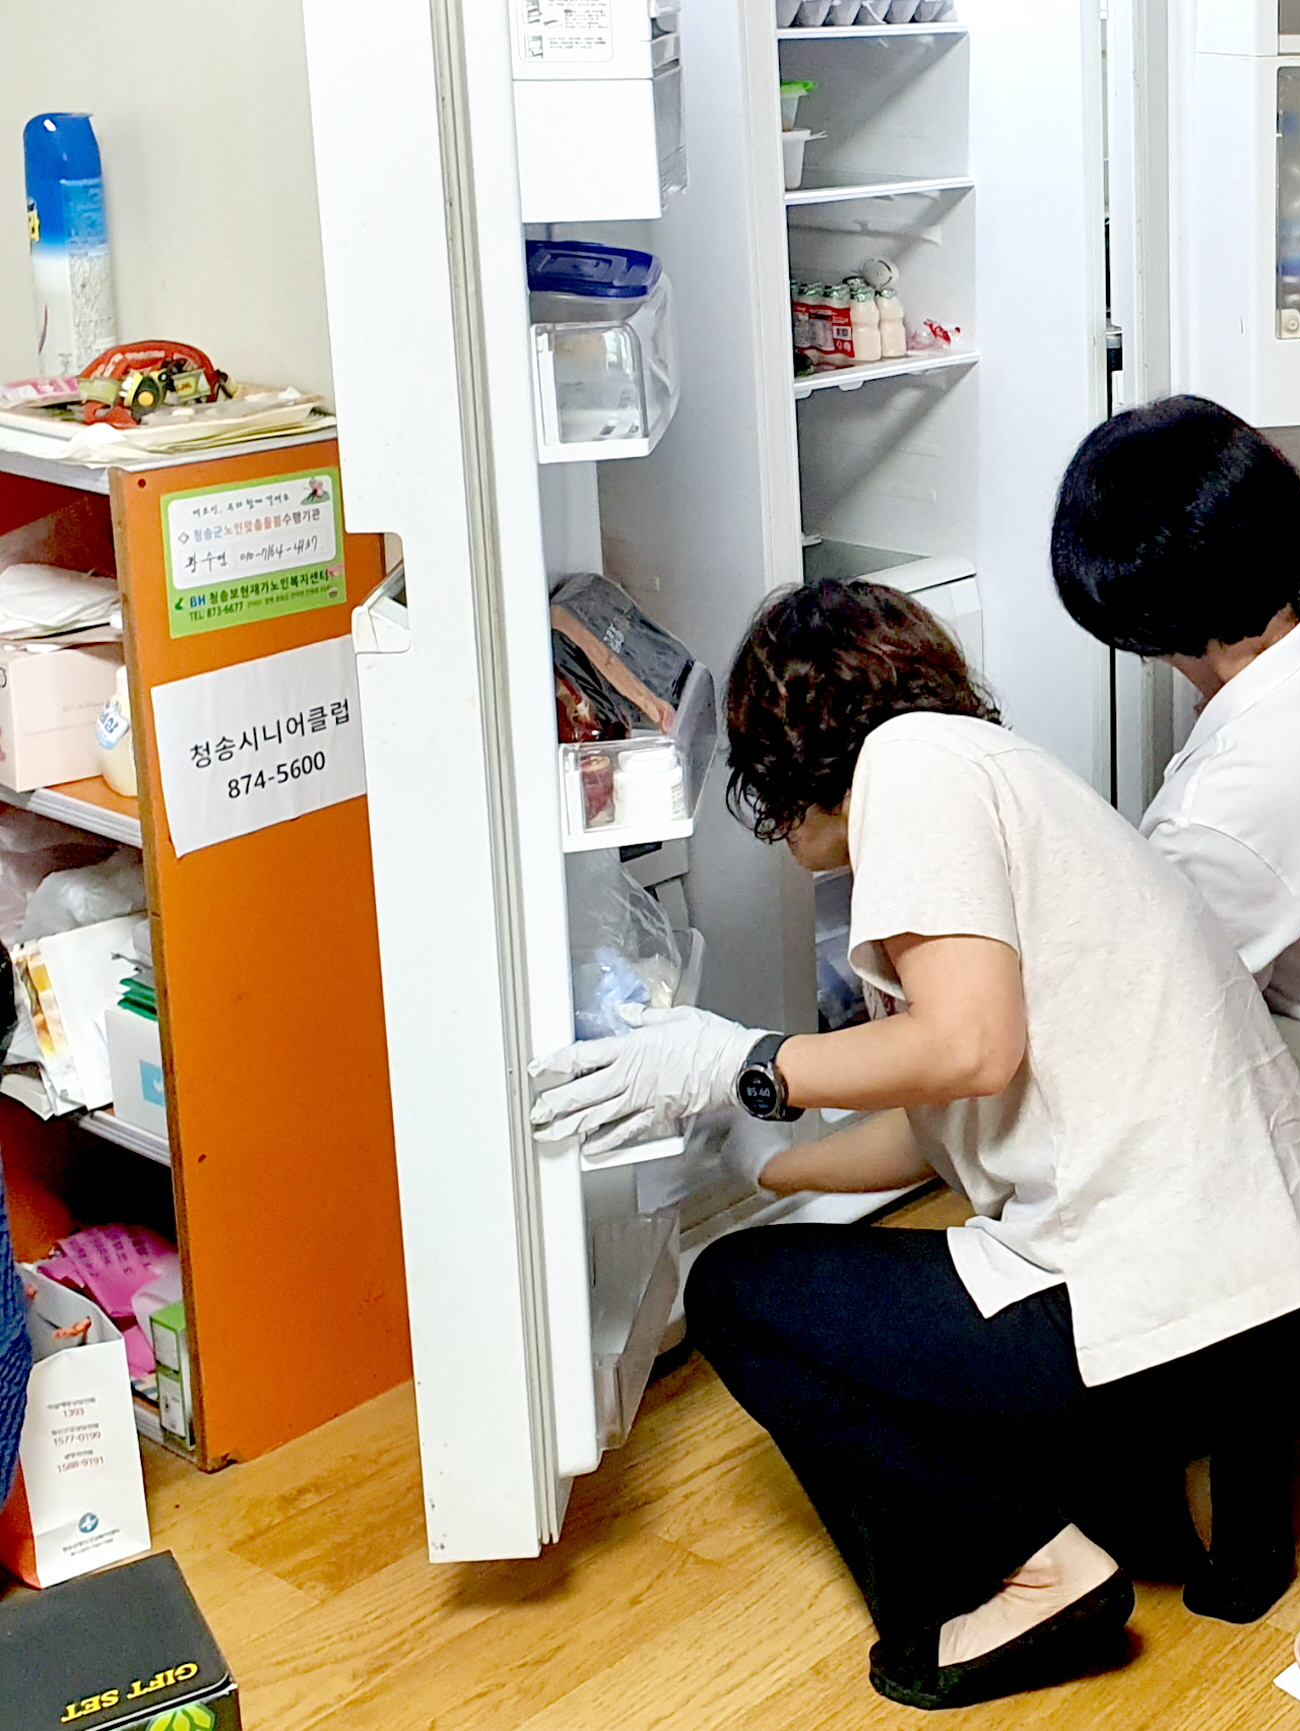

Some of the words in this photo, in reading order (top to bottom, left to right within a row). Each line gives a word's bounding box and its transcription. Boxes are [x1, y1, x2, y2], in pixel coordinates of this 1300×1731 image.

[189, 595, 206, 608] BH
[190, 698, 350, 769] 청송시니어클럽
[228, 751, 326, 799] 874-5600
[126, 1661, 199, 1700] GIFT
[60, 1689, 120, 1724] SET
